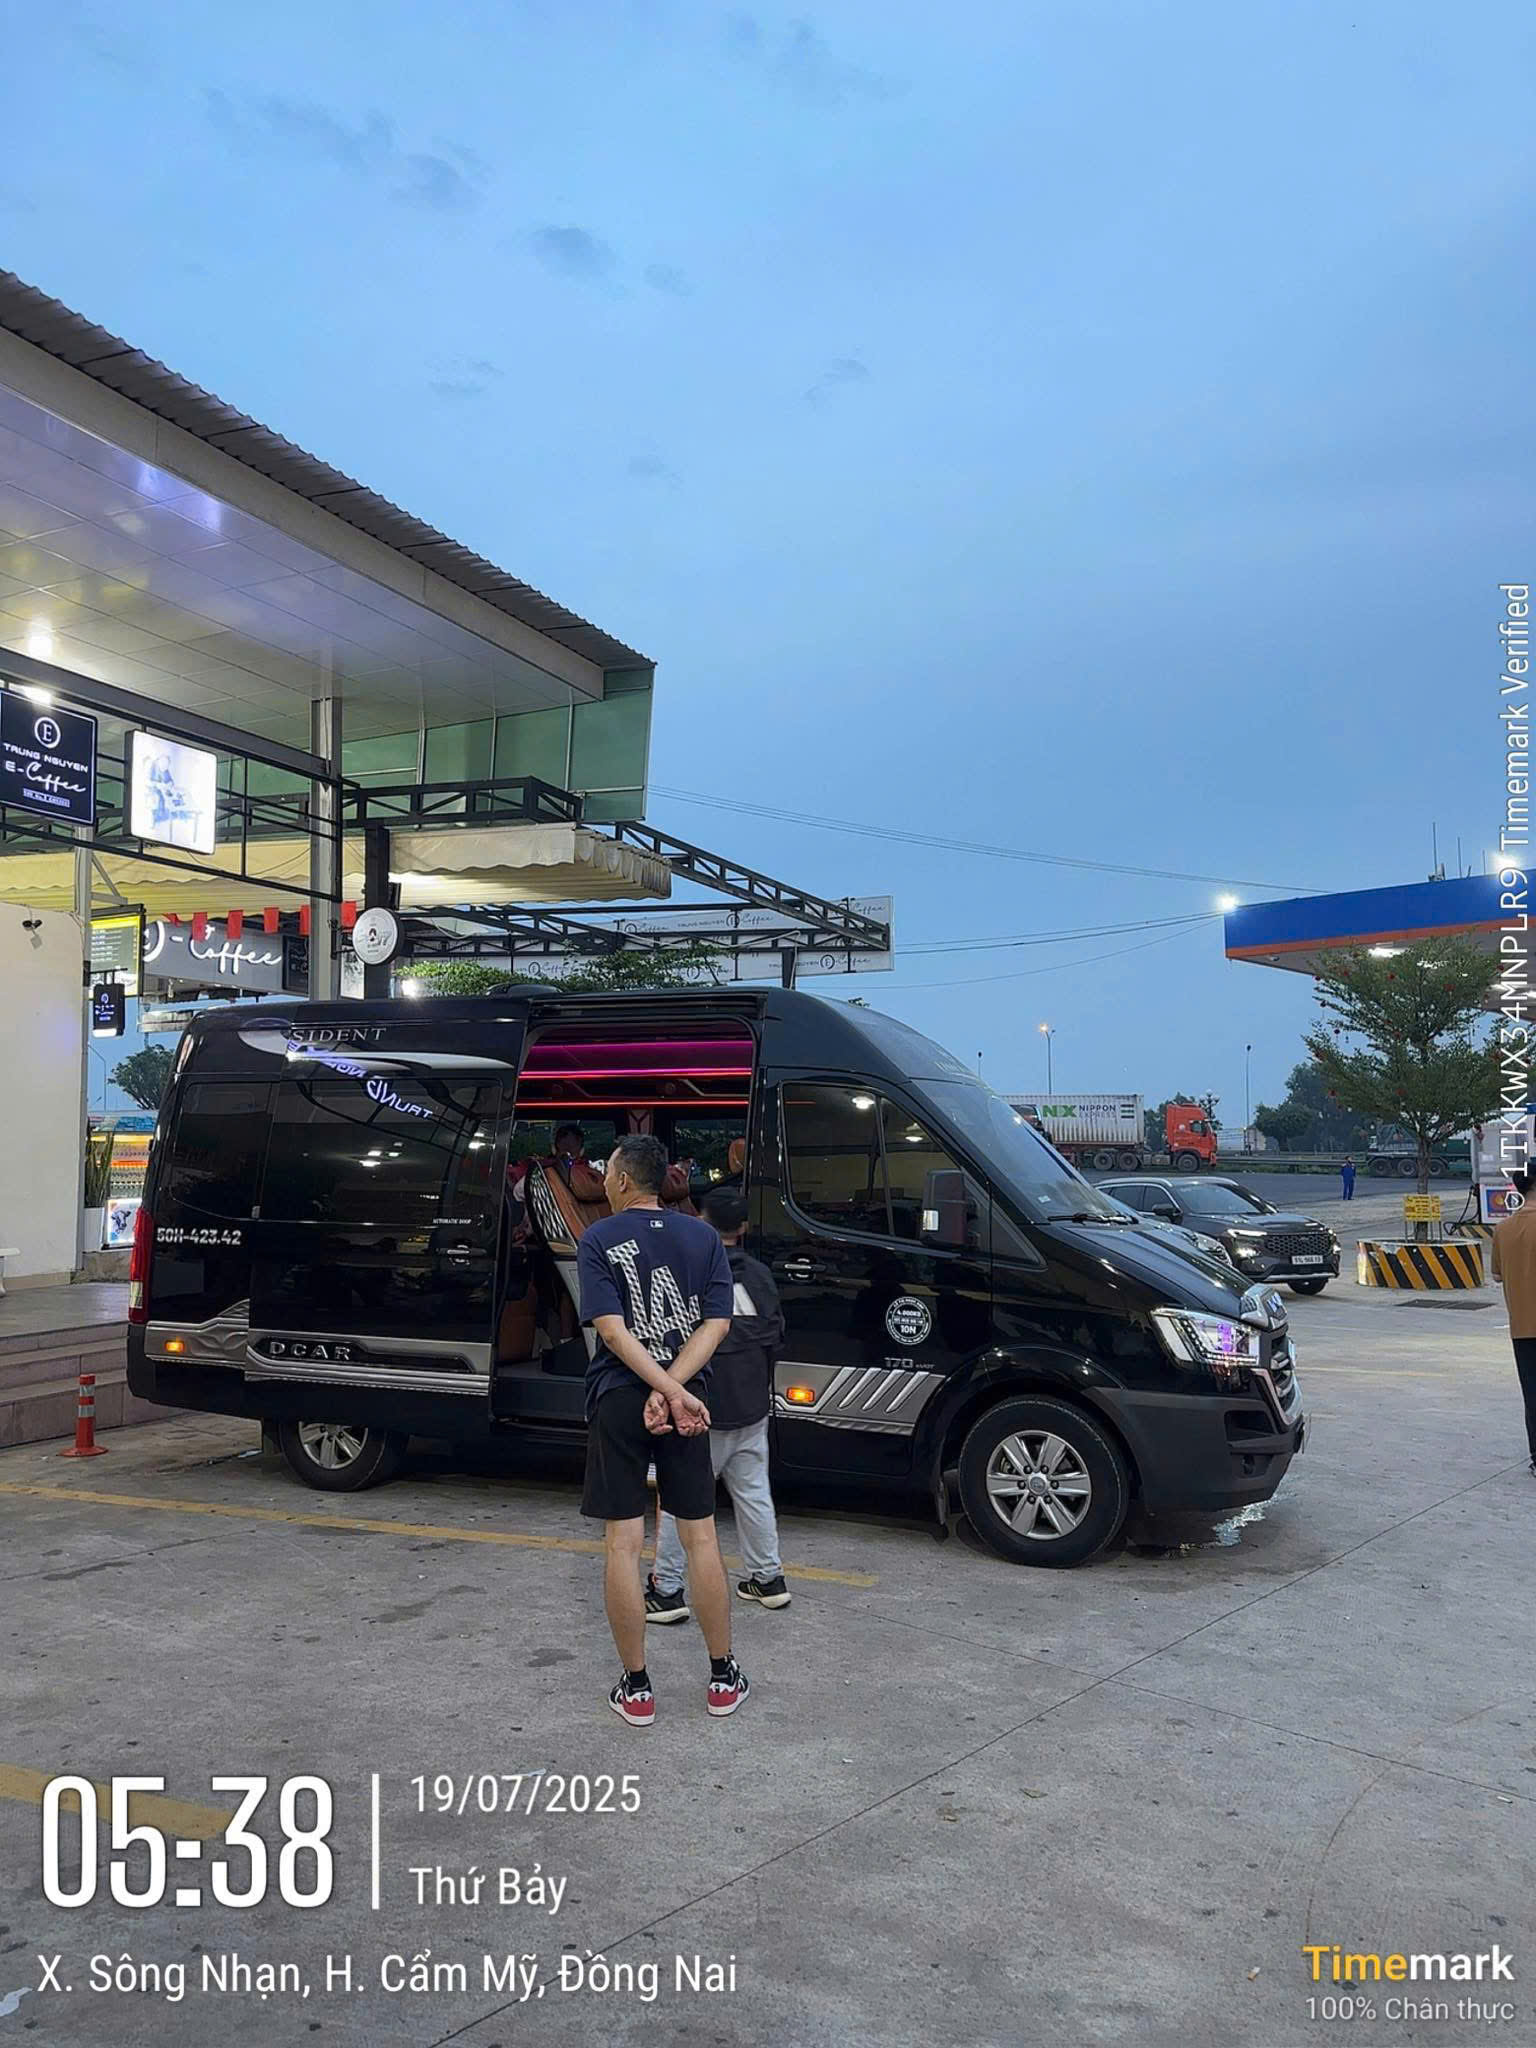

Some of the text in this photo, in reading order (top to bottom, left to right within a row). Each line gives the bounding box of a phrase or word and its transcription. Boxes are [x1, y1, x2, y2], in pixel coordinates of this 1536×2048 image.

[3, 742, 89, 773] TRUNG NGUYEN
[292, 1027, 387, 1042] SIDENT
[1042, 1104, 1117, 1118] NX NIPPON
[156, 1227, 243, 1246] 50H-423.42
[269, 1341, 351, 1361] DCAR
